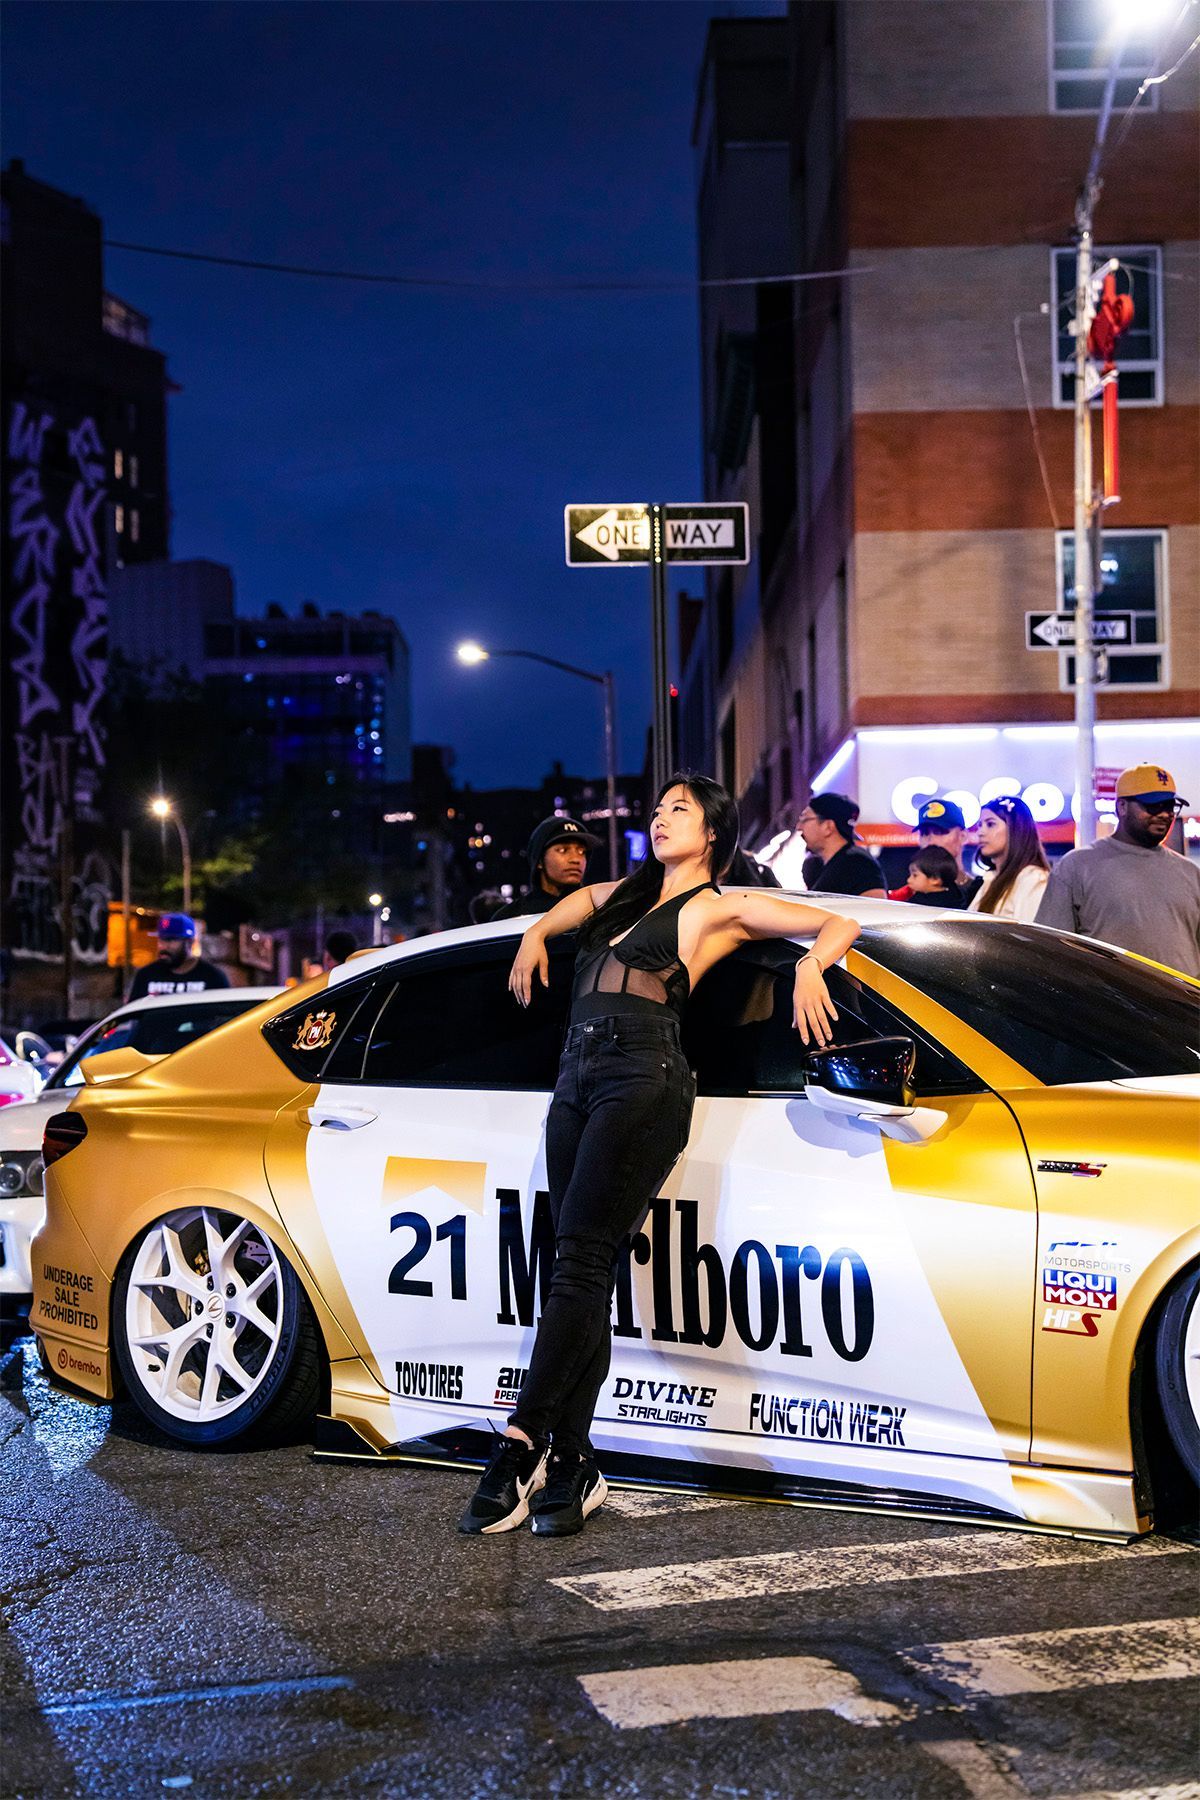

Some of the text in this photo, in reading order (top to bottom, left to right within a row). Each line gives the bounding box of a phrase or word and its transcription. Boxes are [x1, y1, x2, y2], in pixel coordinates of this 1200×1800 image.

[597, 523, 722, 545] ONE WAY
[388, 1211, 467, 1300] 21
[1045, 1256, 1132, 1273] MOTORSPORTS
[44, 1264, 94, 1293] UNDERAGE
[496, 1188, 874, 1362] Mrlboro
[1044, 1270, 1112, 1292] LIQUI
[55, 1287, 80, 1308] SALE
[1044, 1286, 1115, 1309] MOLY
[40, 1301, 98, 1330] PROHIBITED
[1042, 1308, 1102, 1338] HPS
[69, 1355, 102, 1377] brembo
[612, 1378, 717, 1408] DIVINE
[618, 1404, 708, 1427] STARLIGHTS
[750, 1393, 907, 1446] FUNCTION WERK
